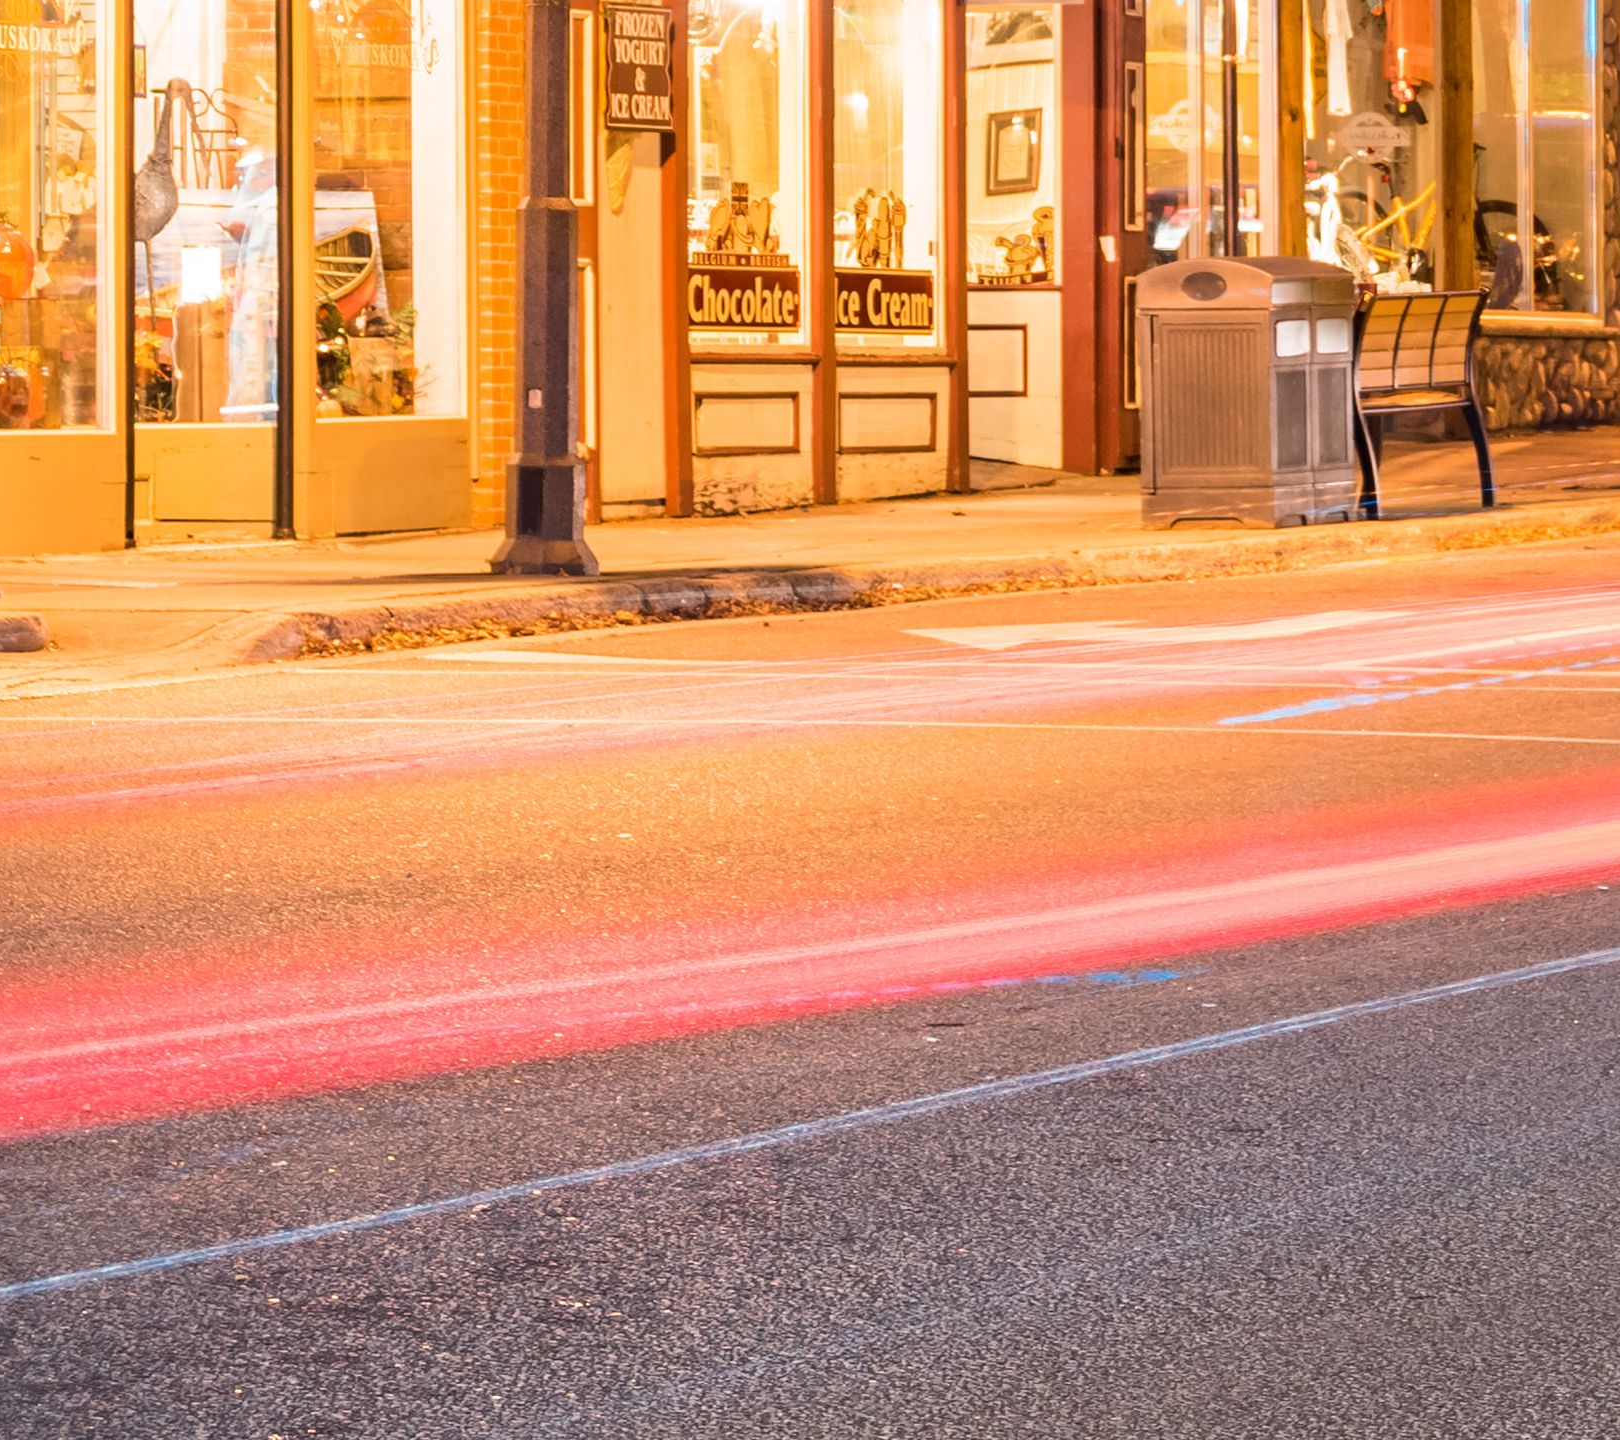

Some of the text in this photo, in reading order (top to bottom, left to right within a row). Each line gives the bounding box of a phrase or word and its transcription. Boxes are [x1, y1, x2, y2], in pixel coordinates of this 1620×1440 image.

[614, 11, 665, 39] FROZEN
[613, 37, 666, 66] YOGURT
[634, 66, 646, 92] &
[610, 92, 670, 120] ICE CREAM
[866, 278, 930, 327] Cream
